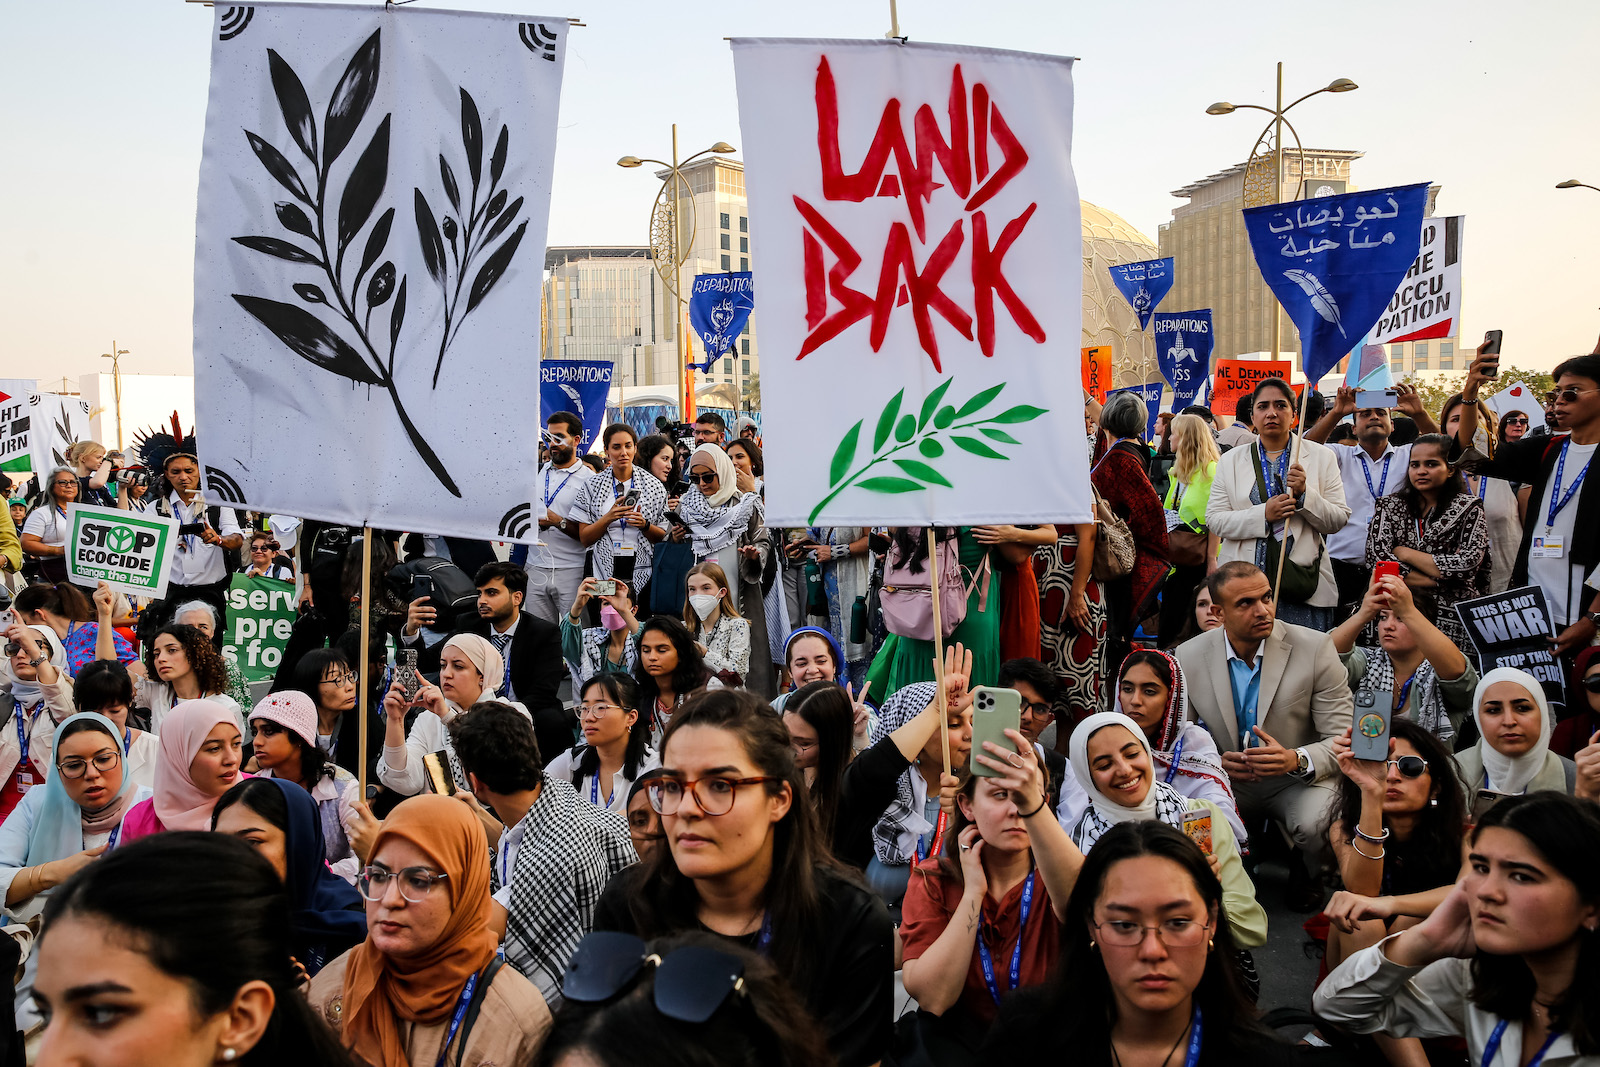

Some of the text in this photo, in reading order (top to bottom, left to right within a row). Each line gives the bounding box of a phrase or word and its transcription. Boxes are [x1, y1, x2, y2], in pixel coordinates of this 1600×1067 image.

[815, 55, 1029, 245] LAND
[1299, 157, 1345, 176] CITY
[1155, 319, 1208, 333] REPARATIONS
[1376, 291, 1450, 338] PATION
[541, 366, 612, 383] REPARATIONS
[1239, 367, 1284, 379] DEMAND
[80, 523, 156, 554] STOP
[78, 548, 151, 571] ECOCIDE
[76, 565, 105, 579] change
[107, 570, 127, 582] the
[130, 573, 150, 585] law
[224, 588, 297, 611] serv
[1469, 594, 1536, 619] THIS IS NOT
[1473, 607, 1549, 644] WAR
[246, 639, 286, 668] fo
[1495, 650, 1553, 668] STOP THIS
